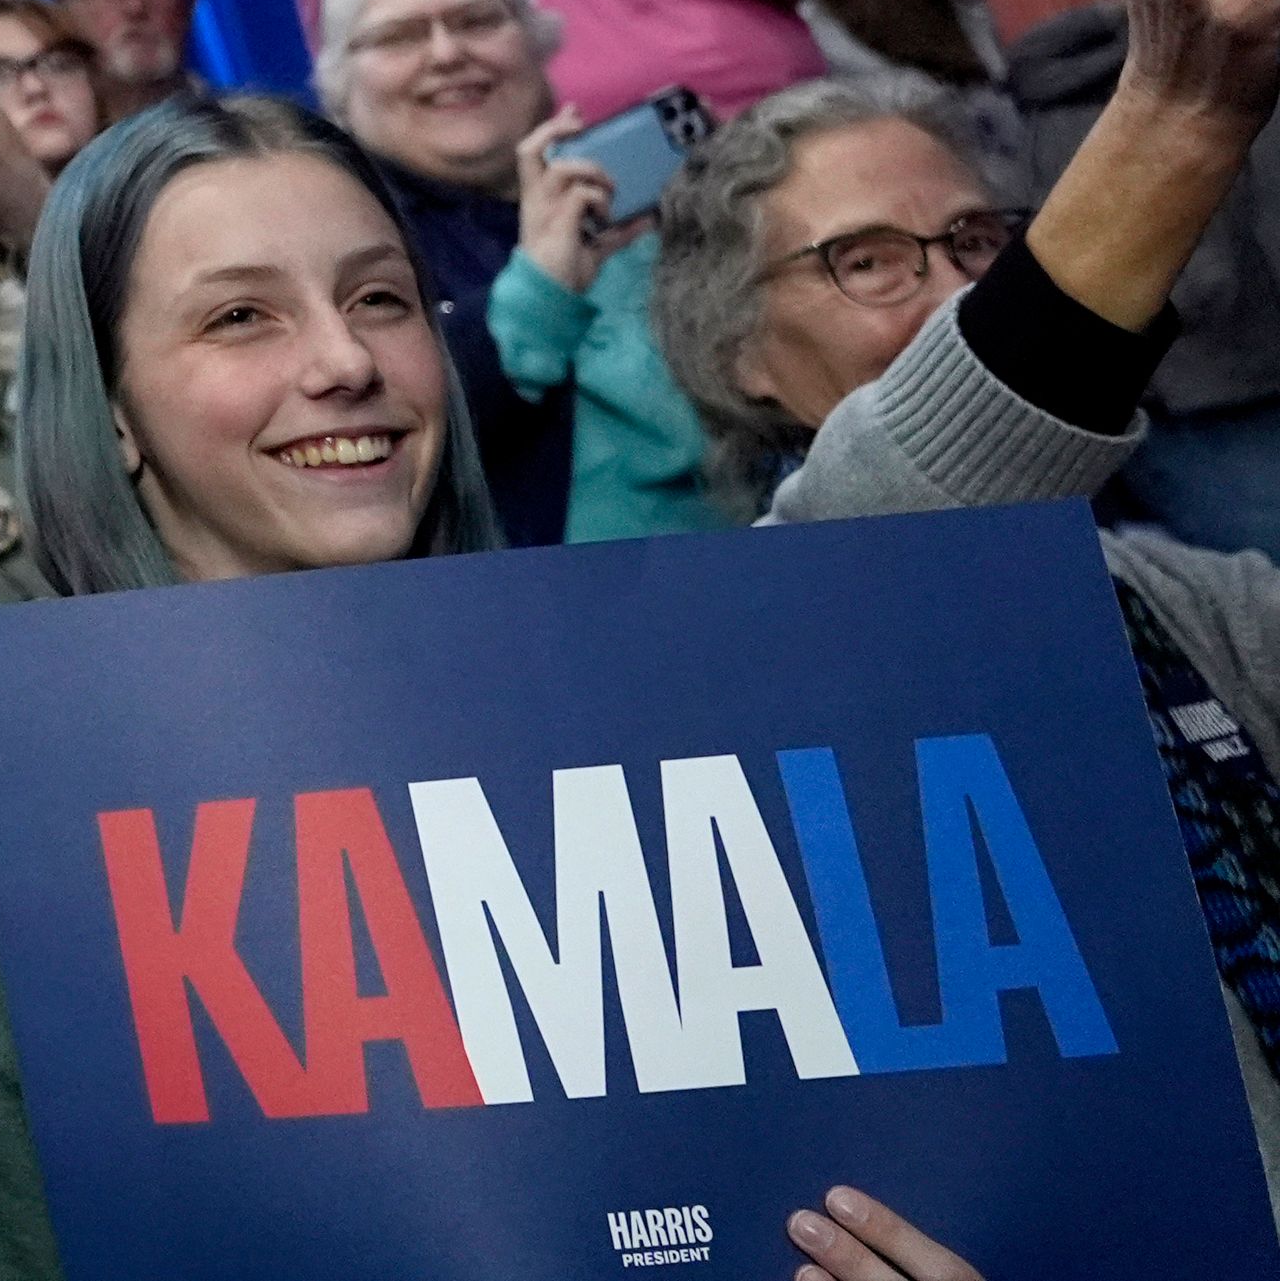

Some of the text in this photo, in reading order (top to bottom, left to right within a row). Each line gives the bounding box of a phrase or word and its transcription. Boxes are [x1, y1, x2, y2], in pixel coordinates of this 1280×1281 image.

[97, 734, 1119, 1123] KAMALA
[607, 1205, 713, 1250] HARRIS
[622, 1247, 710, 1267] PRESIDENT
